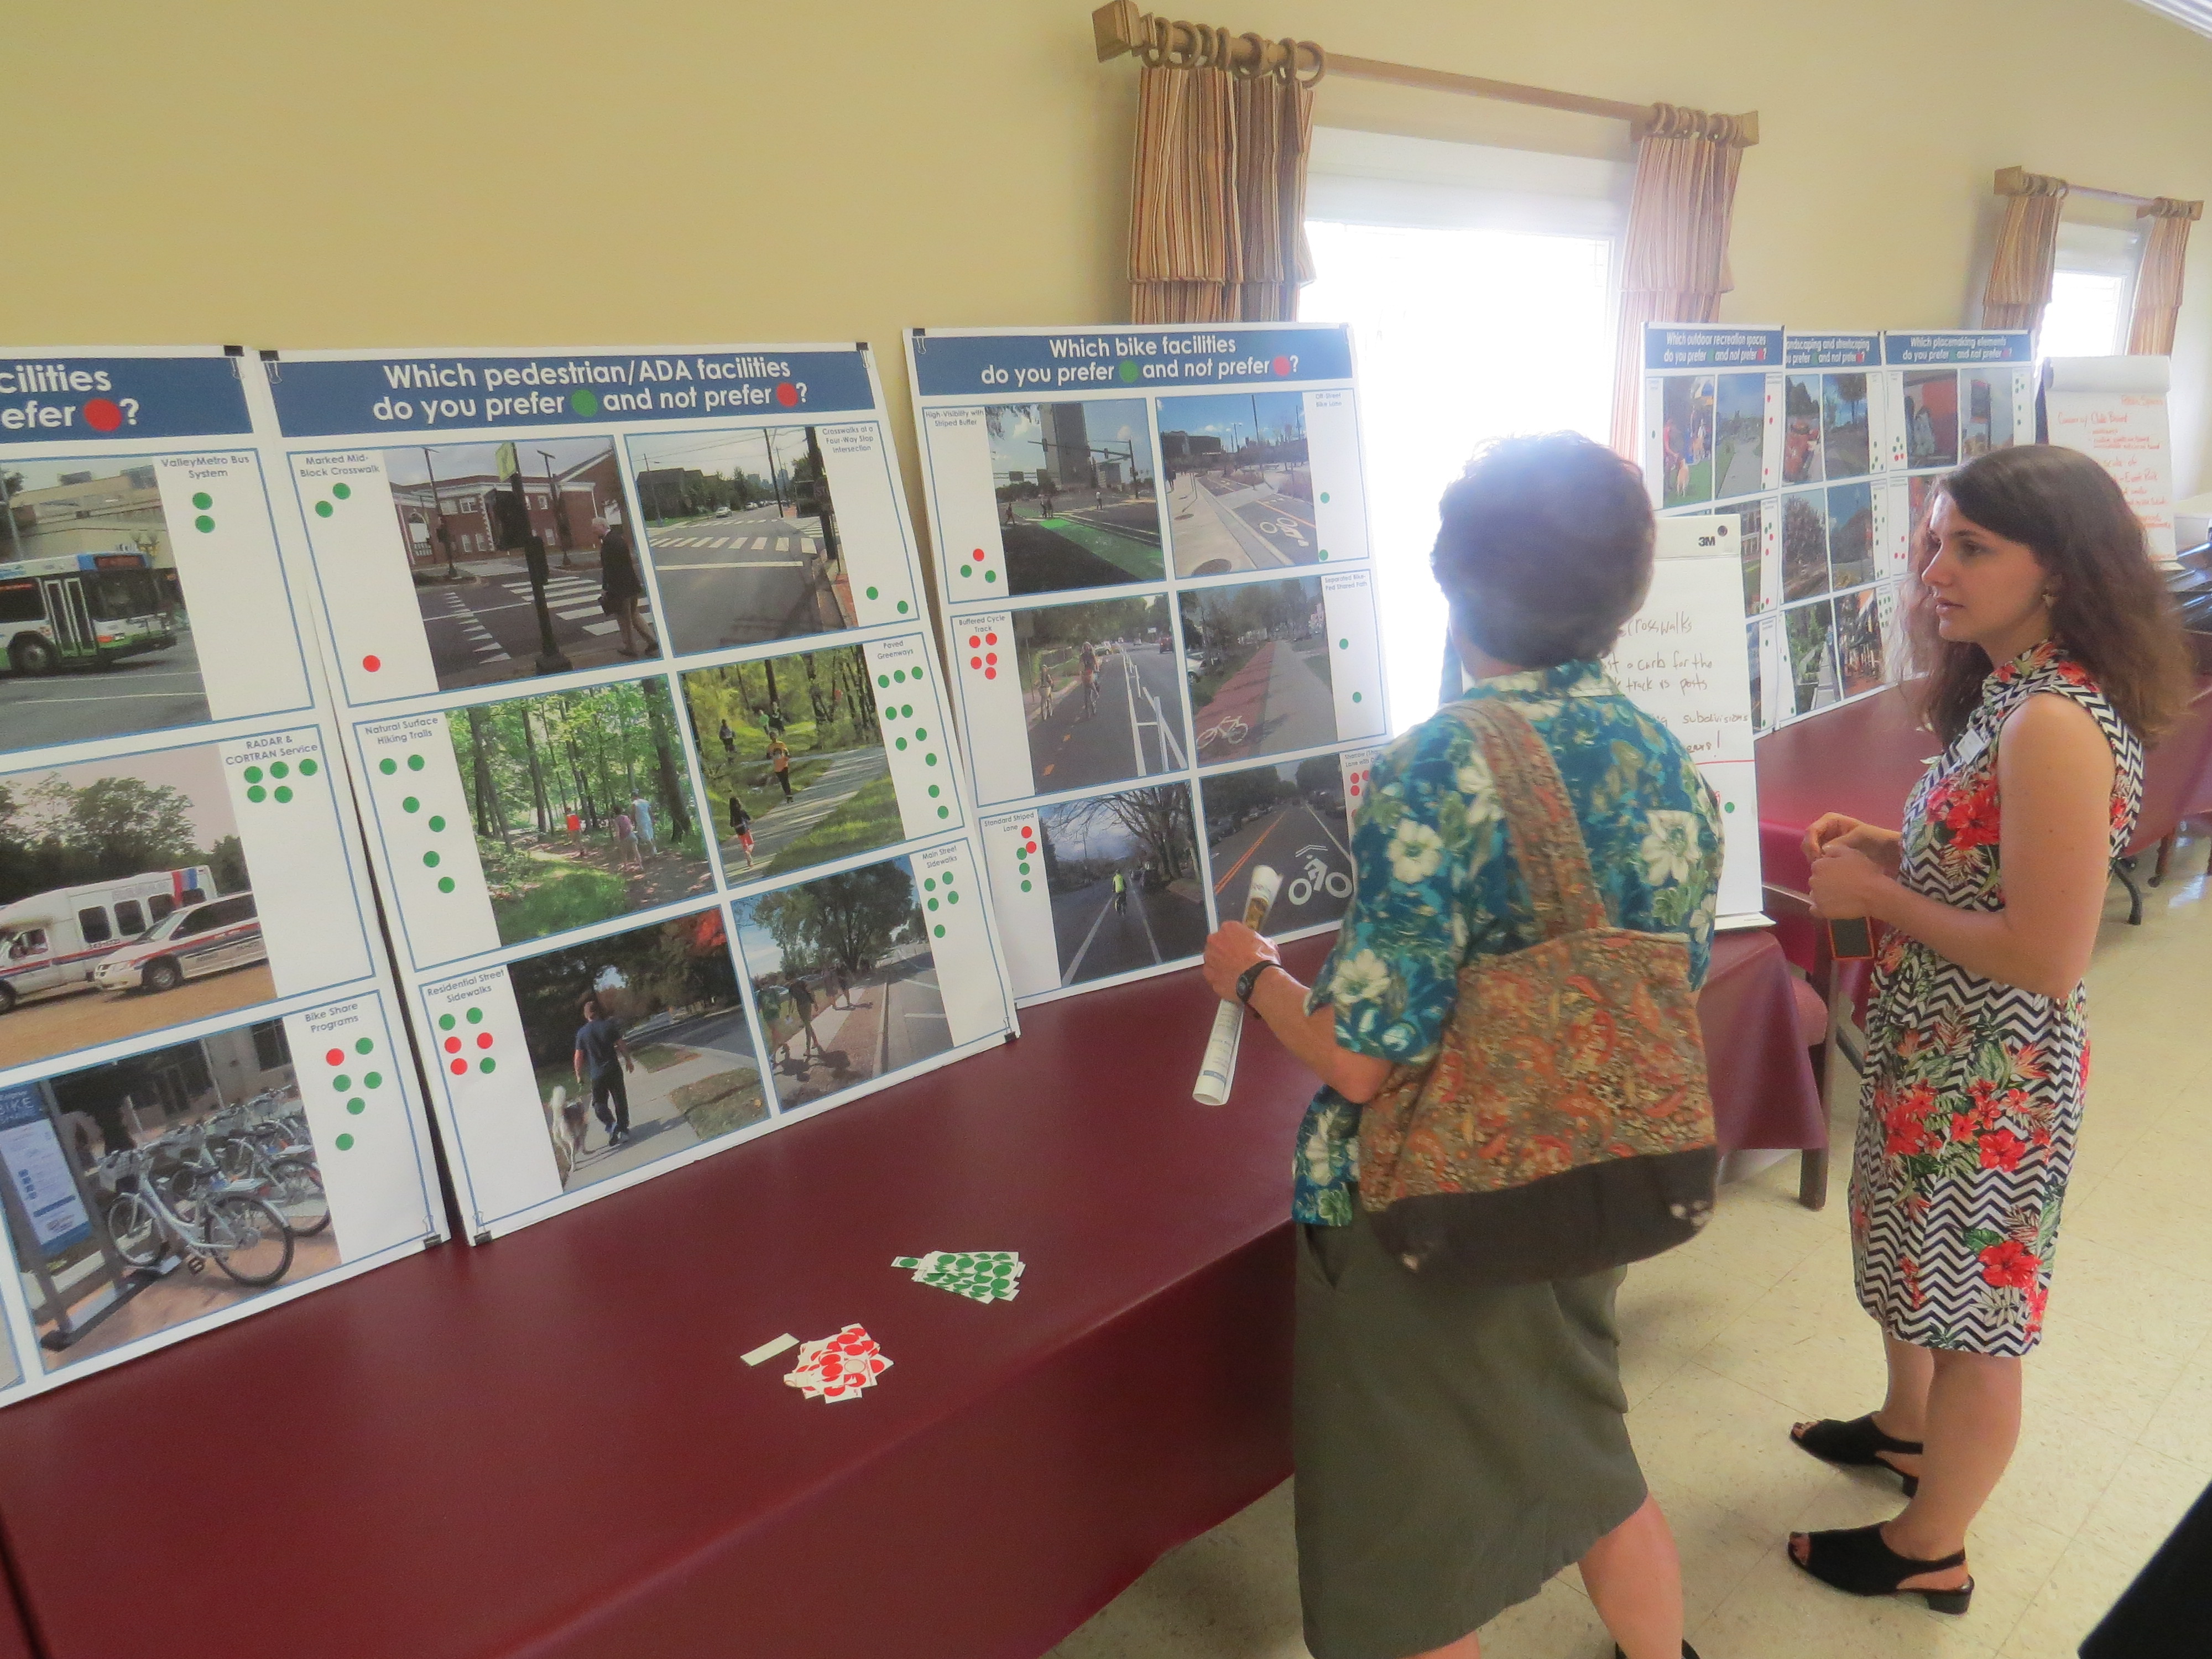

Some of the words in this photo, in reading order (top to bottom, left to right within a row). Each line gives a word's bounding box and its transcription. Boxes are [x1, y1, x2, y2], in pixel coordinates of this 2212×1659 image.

[1049, 338, 1110, 359] Which
[1116, 337, 1157, 356] bike
[1162, 333, 1237, 354] facilities
[1667, 332, 1686, 345] Which
[1687, 333, 1713, 345] outdoor
[1714, 333, 1745, 345] recreation
[1746, 334, 1766, 347] spaces
[1823, 338, 1835, 349] and
[1911, 337, 1932, 347] Which
[1933, 337, 1976, 349] placemaking
[1664, 349, 1673, 362] do
[1675, 351, 1687, 365] you
[1688, 349, 1707, 364] prefer
[1715, 347, 1728, 361] and
[1729, 348, 1740, 361] not
[1740, 348, 1757, 363] prefer
[1793, 352, 1811, 366] prefer
[1818, 352, 1830, 363] and
[1902, 349, 1912, 360] do
[1914, 352, 1927, 362] you
[1929, 349, 1949, 361] prefer
[1957, 349, 1969, 358] and
[0, 364, 112, 392] cilities
[383, 363, 476, 389] Which
[484, 359, 693, 391] pedestrian/ADA
[697, 357, 791, 380] facilities
[981, 365, 1009, 385] do
[1015, 367, 1051, 388] you
[1057, 362, 1114, 386] prefer
[1142, 359, 1179, 378] and
[1185, 359, 1213, 377] not
[1218, 356, 1270, 379] prefer
[373, 397, 413, 421] do
[422, 398, 476, 424] you
[485, 392, 565, 421] prefer
[603, 388, 653, 411] and
[660, 389, 696, 409] not
[704, 384, 771, 411] prefer
[796, 382, 807, 403] ?
[1, 401, 76, 430] efer
[119, 398, 140, 425] ?
[822, 426, 858, 436] Crosswalks
[826, 436, 857, 444] Four-Way
[161, 455, 227, 468] ValleyMetro
[231, 454, 249, 464] Bus
[306, 454, 344, 465] Marked
[347, 453, 369, 462] Mid-
[189, 468, 227, 479] System
[300, 467, 328, 477] Block
[331, 465, 380, 476] Crosswalk
[1698, 536, 1715, 546] 3M
[1325, 575, 1352, 583] Separated
[959, 617, 985, 626] Buffered
[987, 615, 1005, 623] Cycle
[883, 640, 904, 649] Paved
[877, 649, 914, 660] Greenways
[1638, 651, 1666, 670] curb
[1673, 650, 1690, 670] for
[1692, 652, 1712, 670] the
[1626, 676, 1652, 692] track
[1680, 673, 1707, 696] posts
[1683, 711, 1748, 724] subdivisions
[365, 722, 400, 735] Natural
[403, 717, 438, 728] Surface
[246, 736, 282, 749] RADAR
[377, 733, 408, 745] Hiking
[409, 729, 432, 739] Trails
[226, 749, 276, 766] CORTRAN
[279, 744, 317, 757] Service
[984, 816, 1013, 827] Standard
[1014, 812, 1034, 822] Striped
[922, 850, 937, 859] Main
[939, 846, 957, 856] Street
[927, 855, 957, 868] Sidewalks
[427, 976, 477, 997] Residential
[478, 969, 504, 984] Street
[446, 984, 492, 1003] Sidewalks
[305, 1010, 327, 1022] Bike
[329, 1002, 358, 1016] Share
[311, 1014, 359, 1033] Programs
